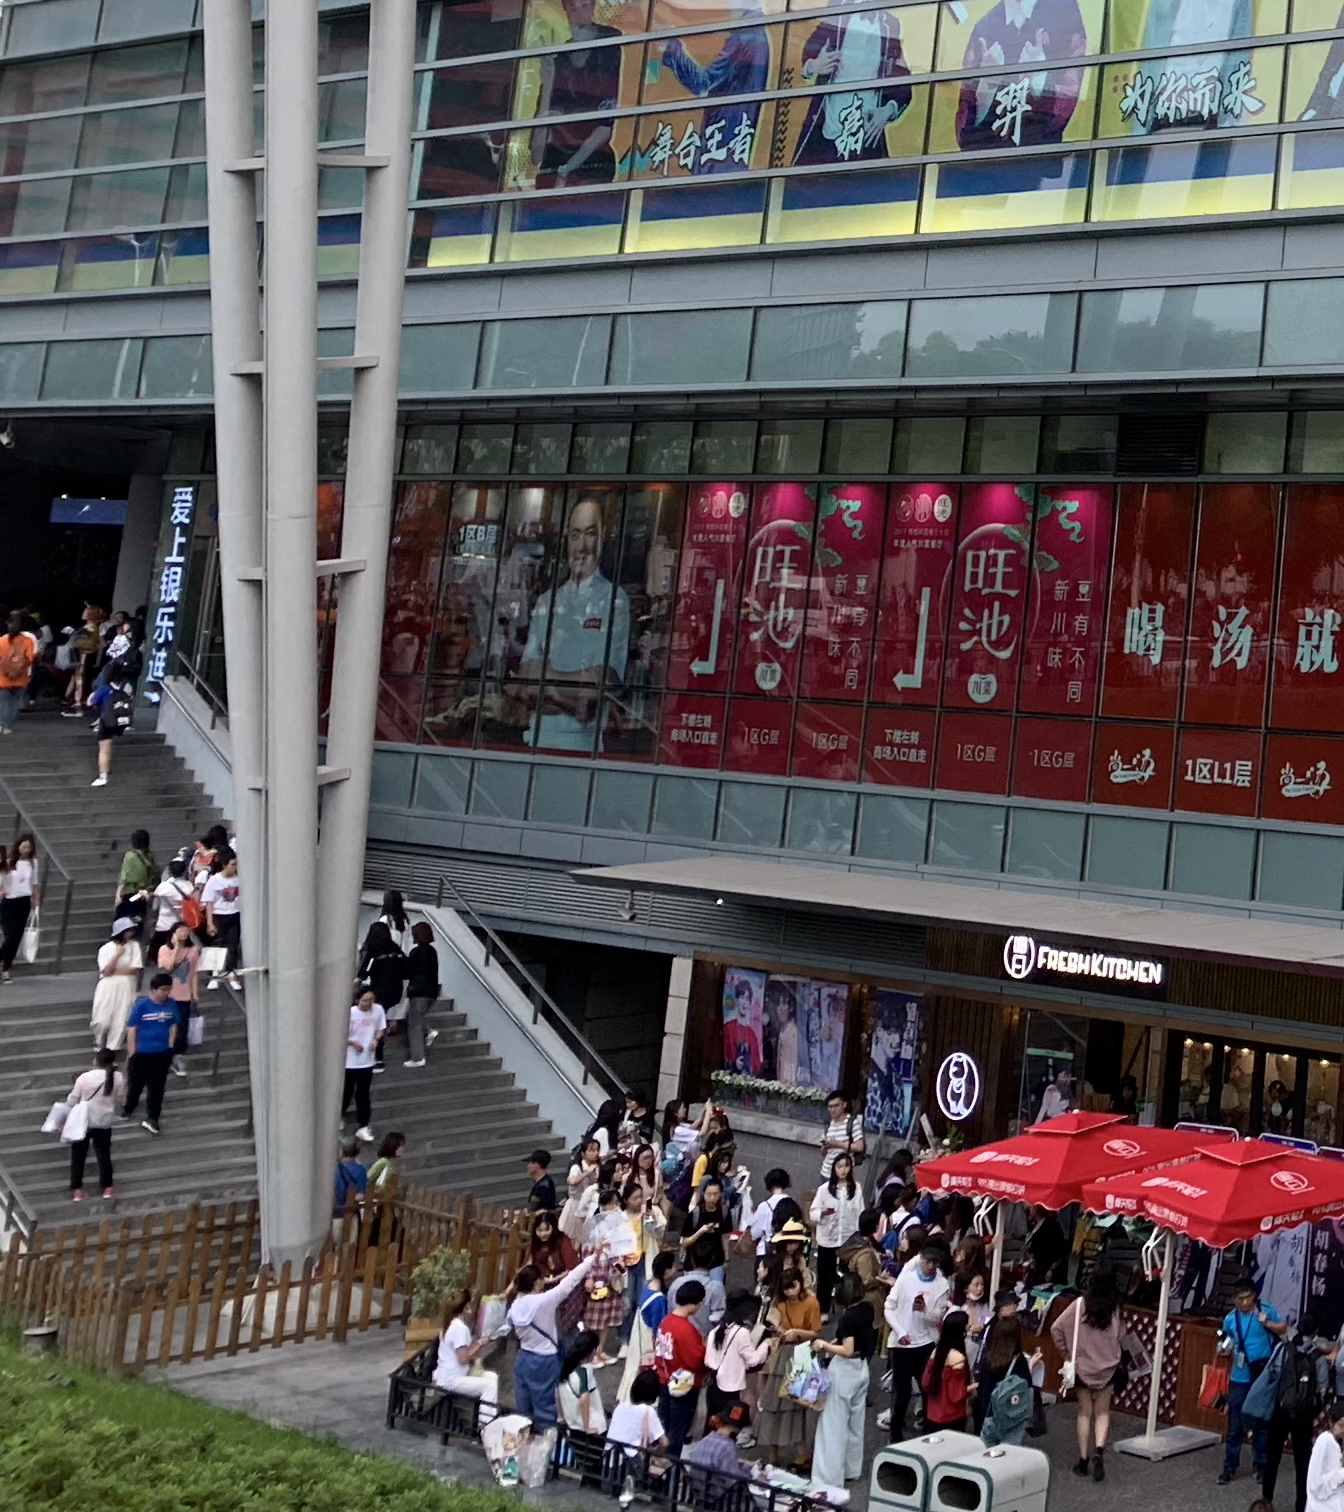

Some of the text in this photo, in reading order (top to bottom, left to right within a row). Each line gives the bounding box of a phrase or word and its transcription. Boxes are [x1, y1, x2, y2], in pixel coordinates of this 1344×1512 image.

[648, 112, 756, 176] 舞台王者
[833, 93, 866, 161] 嘉
[747, 545, 804, 649] 旺池
[959, 548, 1020, 660] 旺池
[1047, 578, 1070, 669] 新川味
[1066, 579, 1092, 703] 豆有不同
[743, 726, 780, 746] 1区G层
[811, 731, 849, 751] 1区G层
[883, 729, 920, 746] 下楼左转
[956, 743, 997, 763] 1区G层
[1031, 748, 1076, 769] 1区G层
[1183, 757, 1253, 788] 1区L1层
